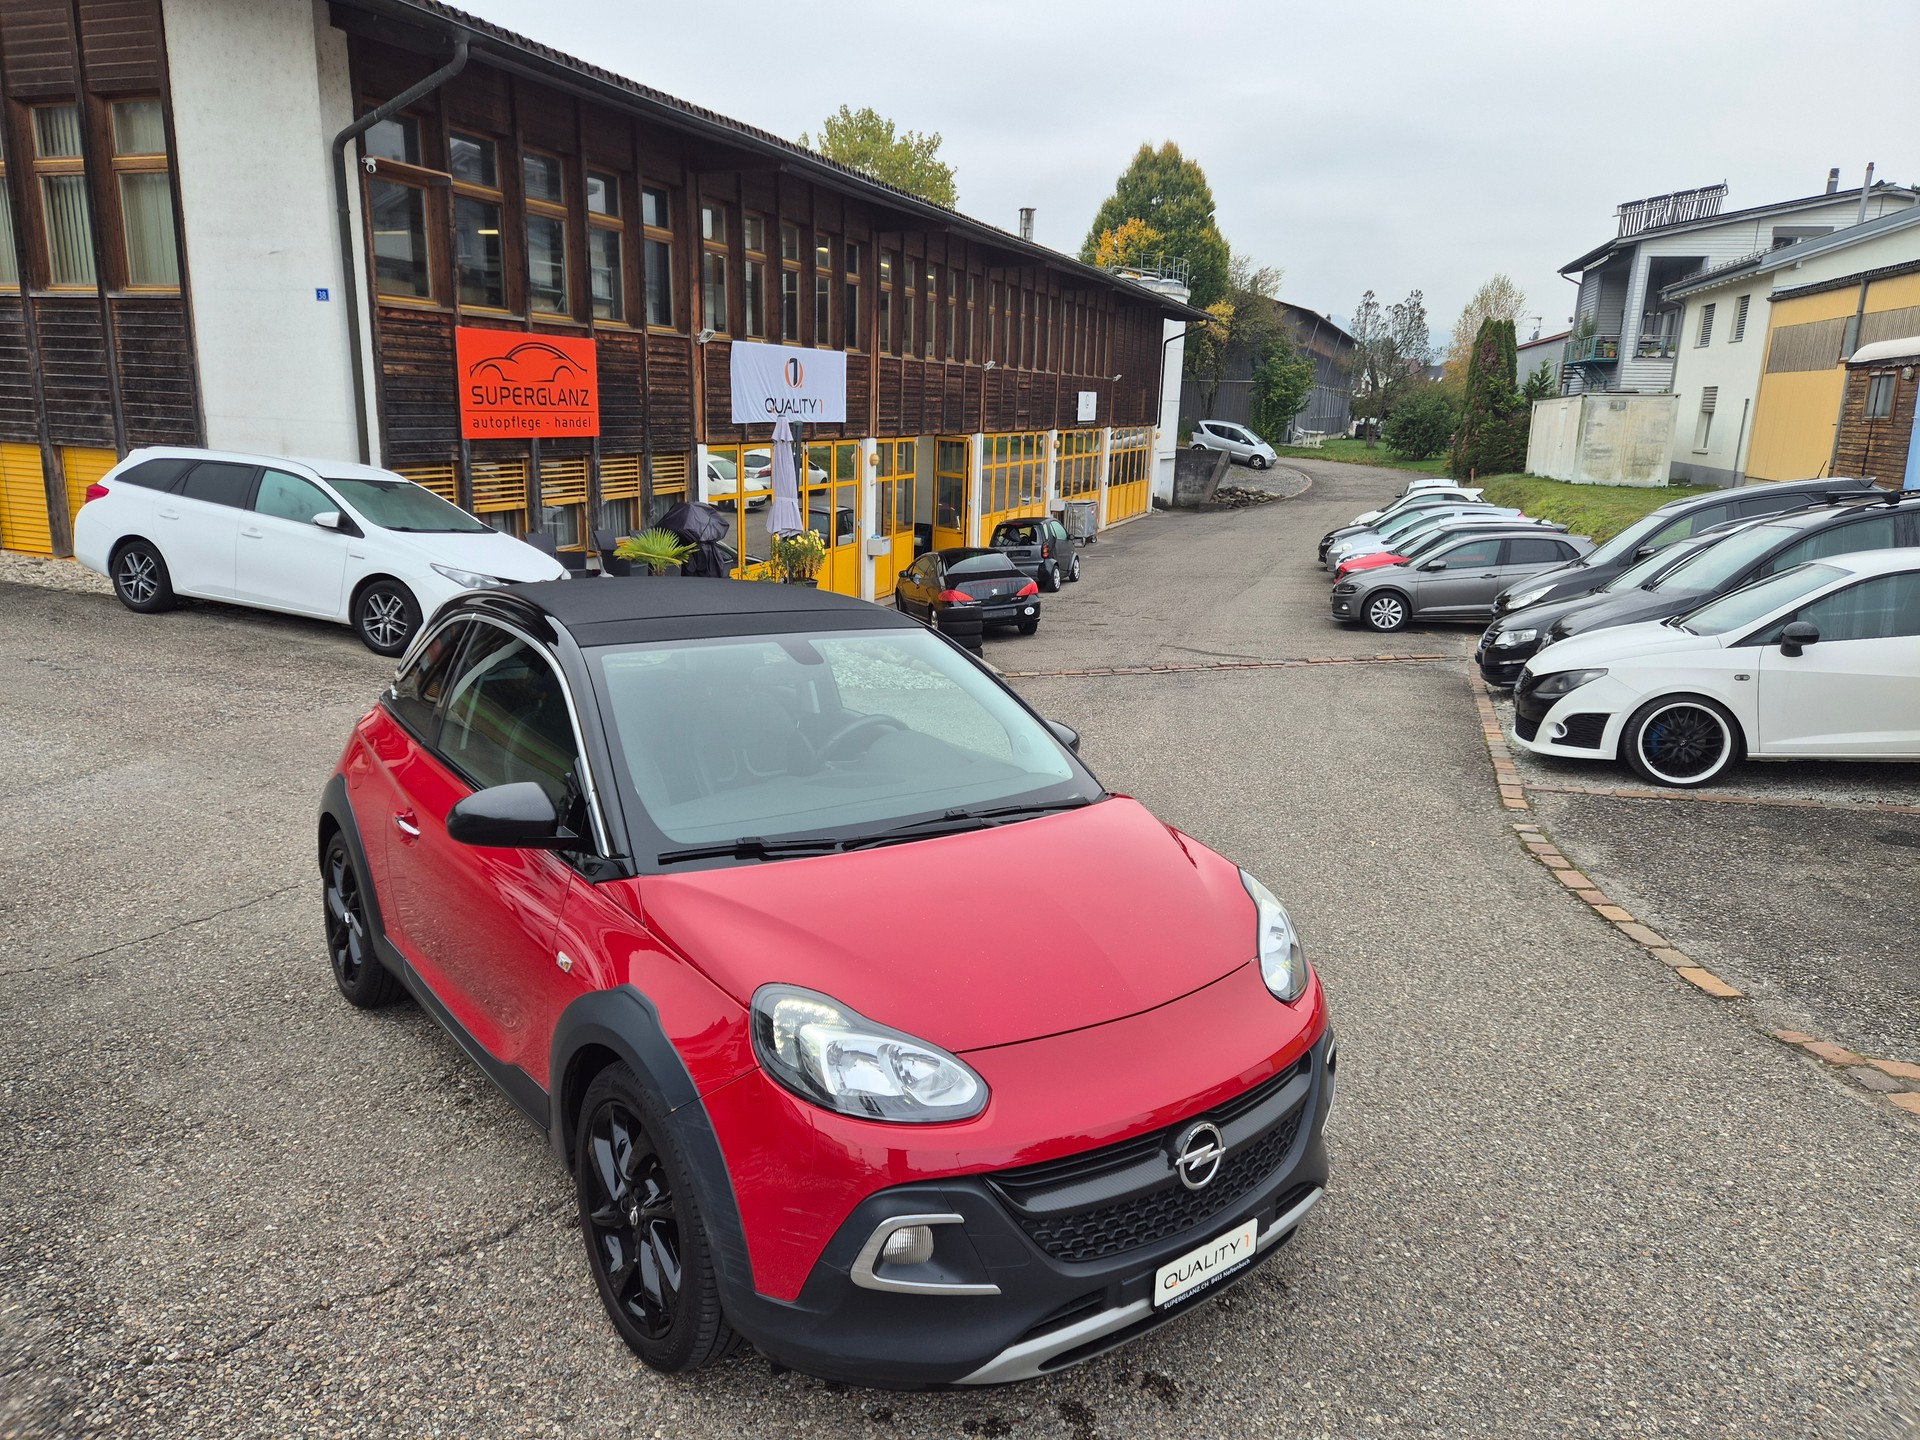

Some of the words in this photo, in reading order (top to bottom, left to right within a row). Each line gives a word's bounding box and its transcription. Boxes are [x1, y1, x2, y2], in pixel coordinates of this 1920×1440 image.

[471, 385, 590, 407] SUPERGLANZ
[764, 397, 817, 414] QUALITY
[819, 399, 824, 414] 1
[473, 416, 541, 431] autopflege
[554, 416, 591, 428] handel
[1164, 1238, 1240, 1290] QUALITY
[1244, 1234, 1250, 1248] 1
